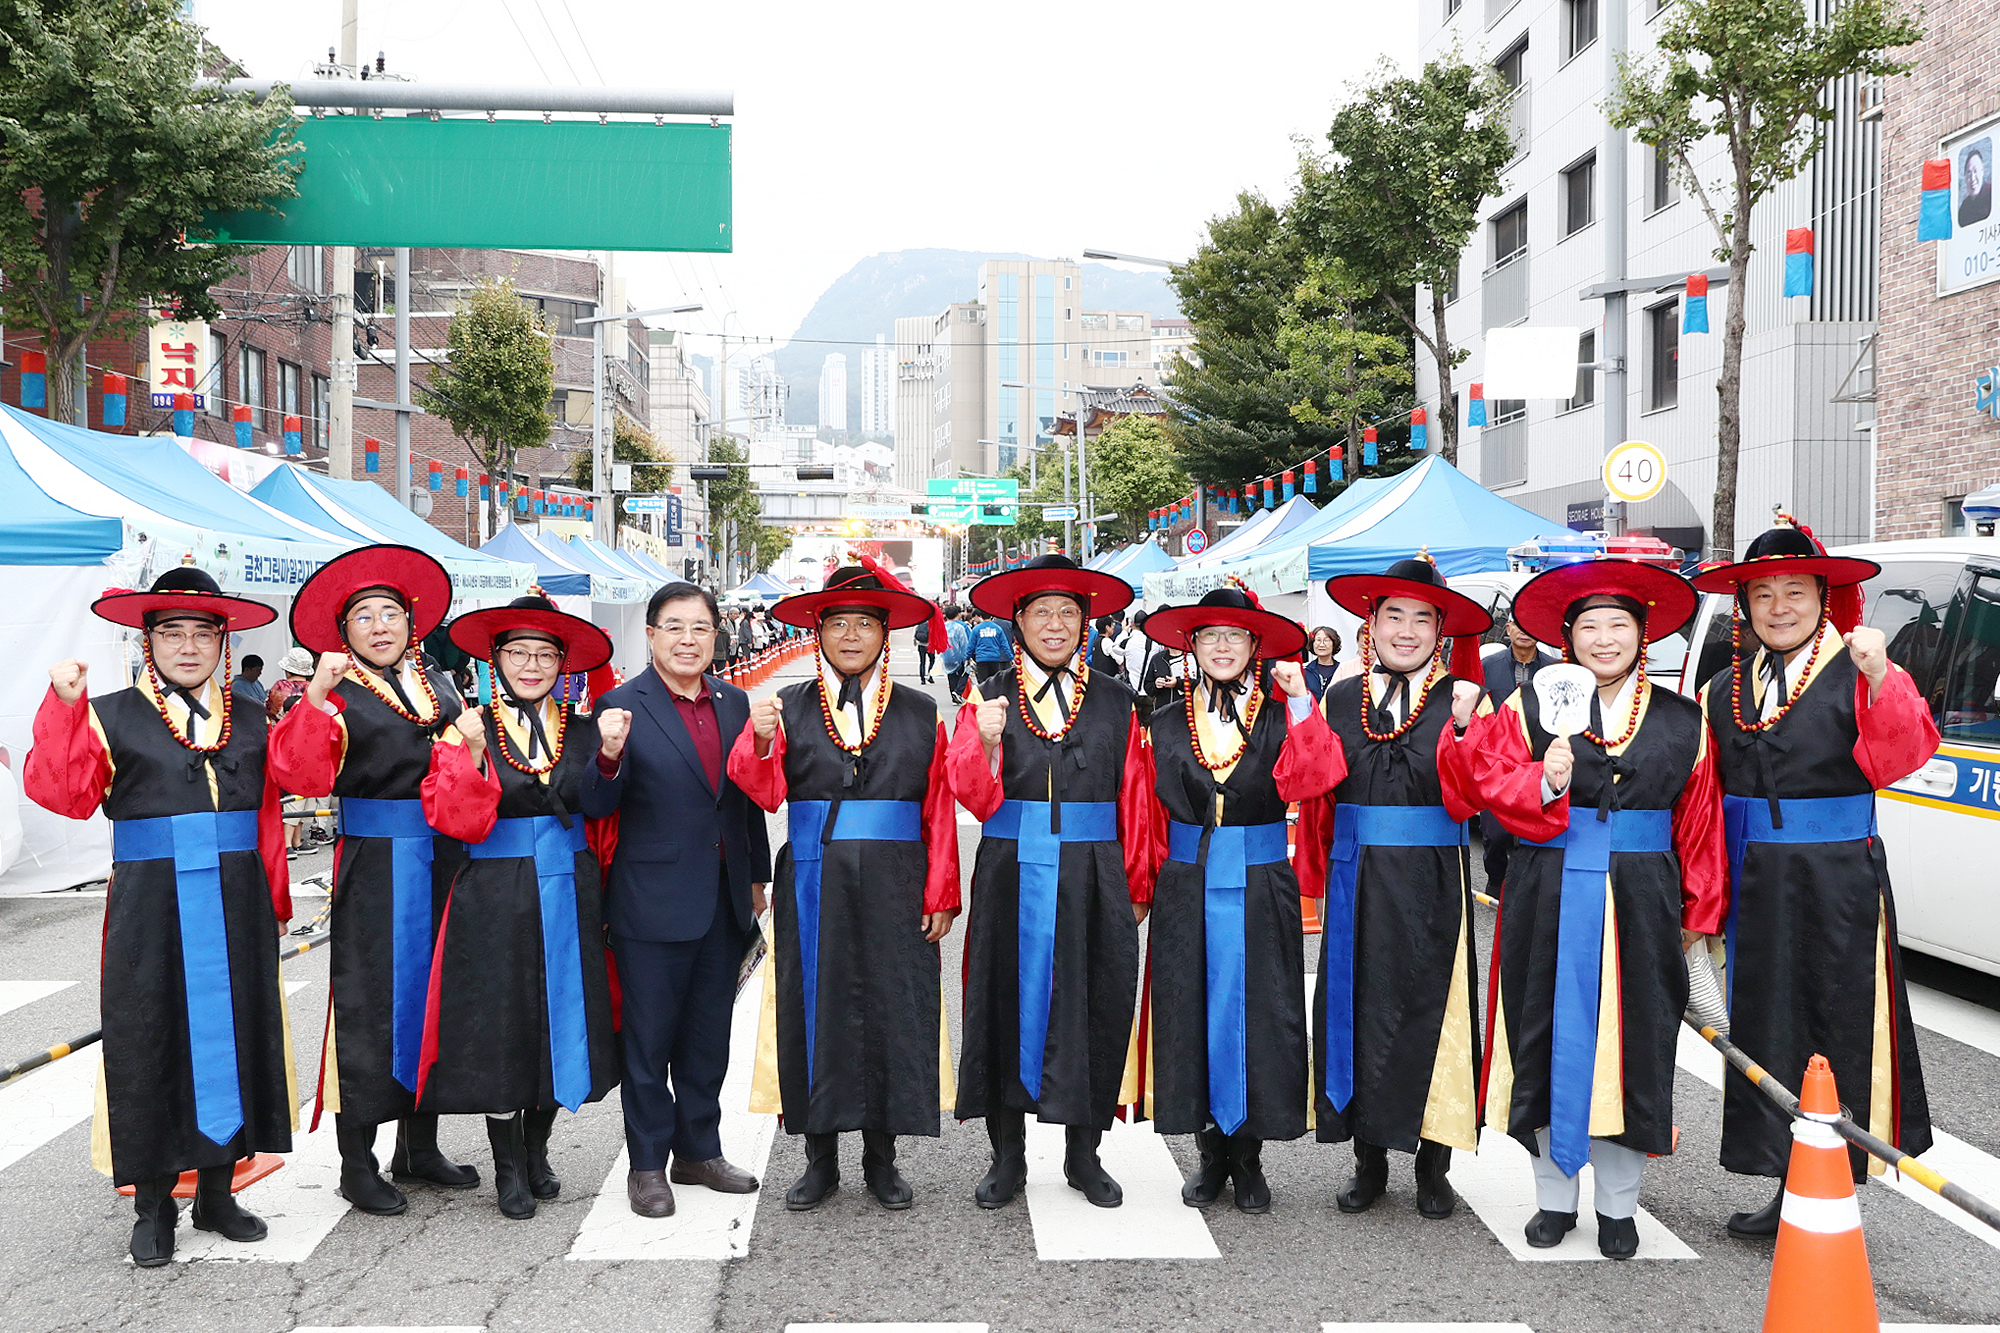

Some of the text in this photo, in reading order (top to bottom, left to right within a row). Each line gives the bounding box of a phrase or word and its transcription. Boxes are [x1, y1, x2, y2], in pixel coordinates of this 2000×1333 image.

[160, 342, 197, 389] 낙지
[1618, 459, 1652, 483] 40
[1568, 509, 1589, 522] SEORAE
[245, 554, 313, 584] 금천그린마일리지
